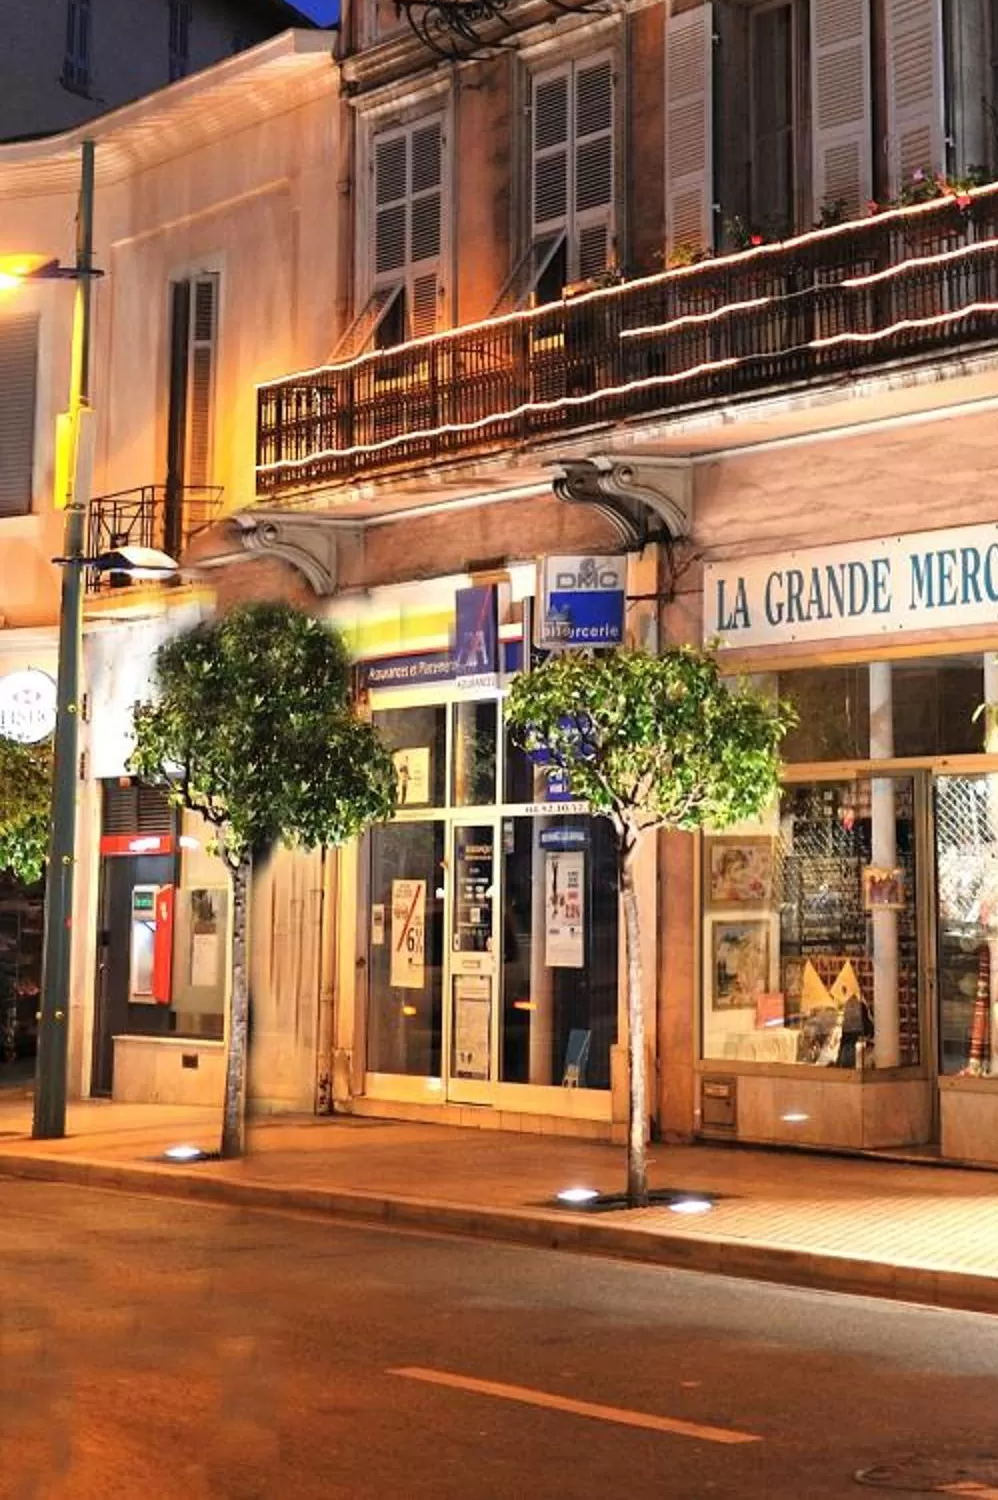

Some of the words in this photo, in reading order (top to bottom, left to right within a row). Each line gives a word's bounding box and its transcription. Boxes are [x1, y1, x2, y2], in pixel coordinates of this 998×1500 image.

[556, 572, 619, 589] DMC
[716, 577, 751, 631] LA
[765, 557, 892, 625] GRANDE
